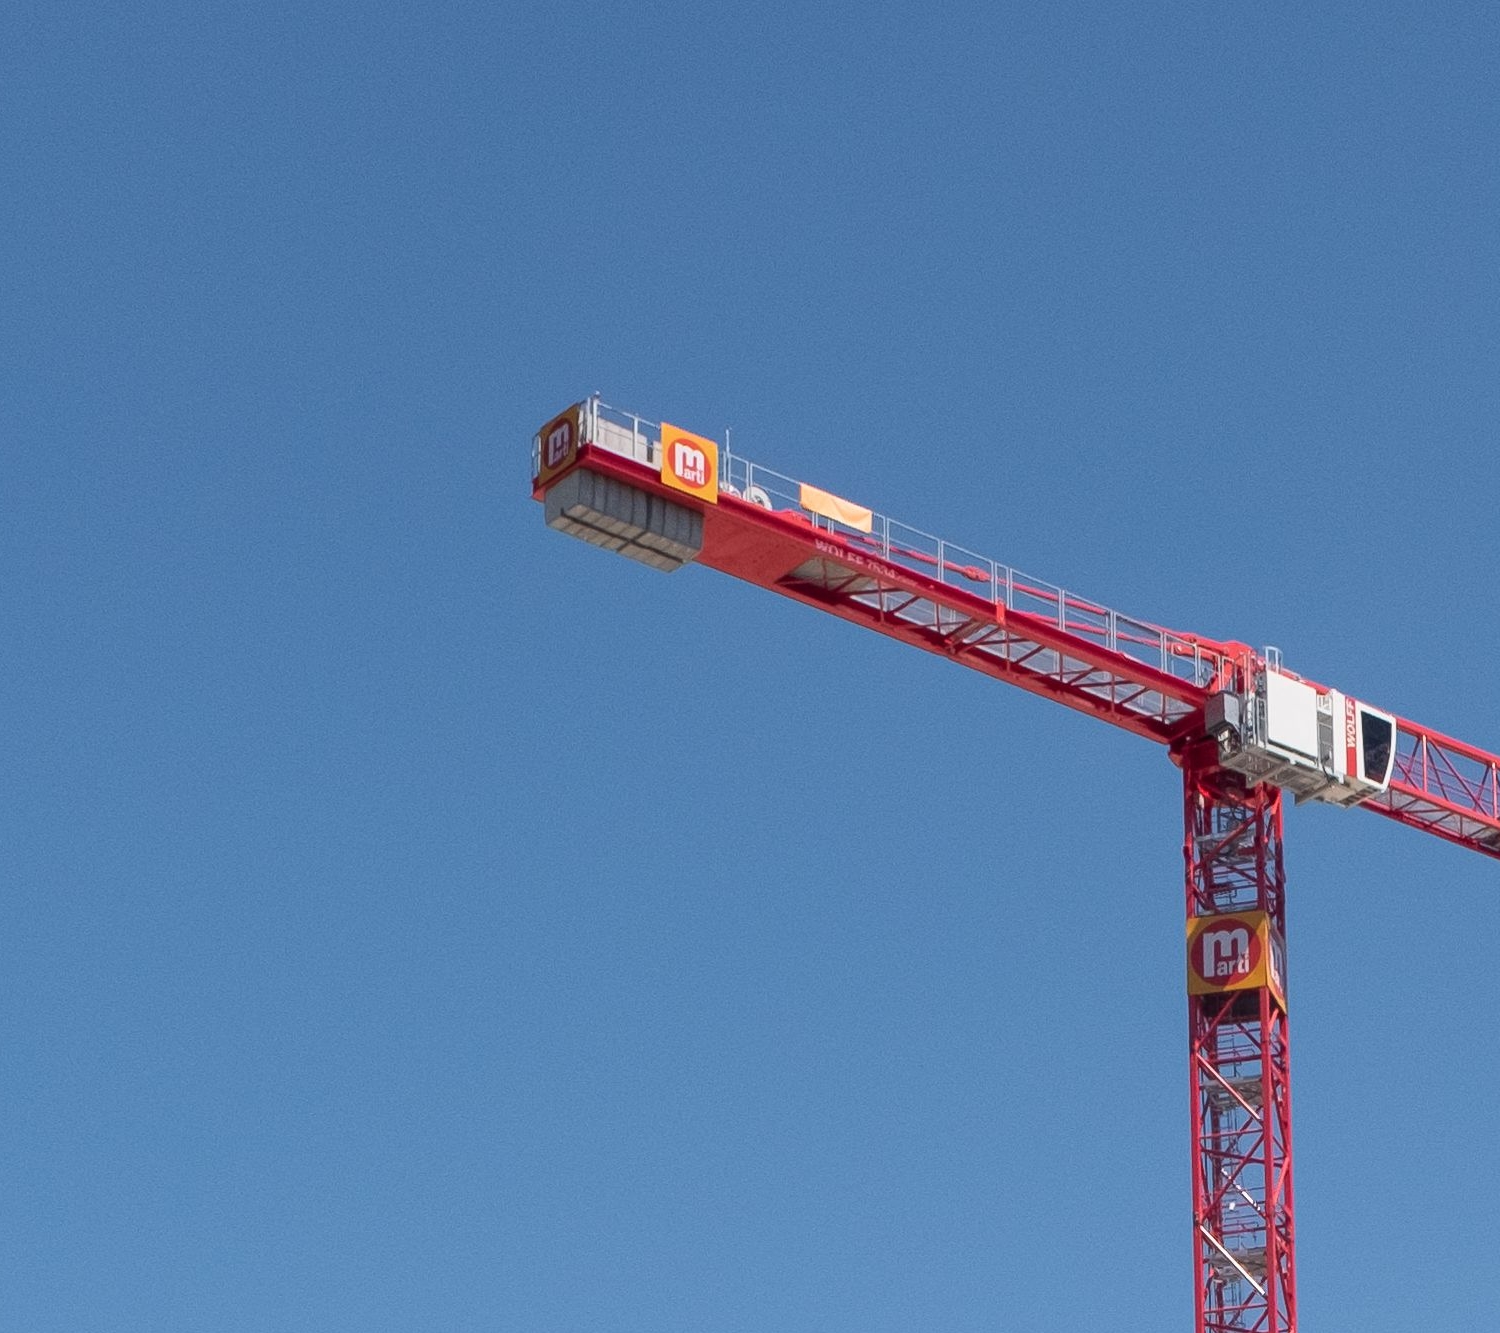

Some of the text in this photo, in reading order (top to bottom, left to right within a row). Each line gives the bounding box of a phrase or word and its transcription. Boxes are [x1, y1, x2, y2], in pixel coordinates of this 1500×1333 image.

[674, 441, 705, 486] marti
[1346, 699, 1357, 748] WOLFF
[1202, 927, 1250, 978] marti
